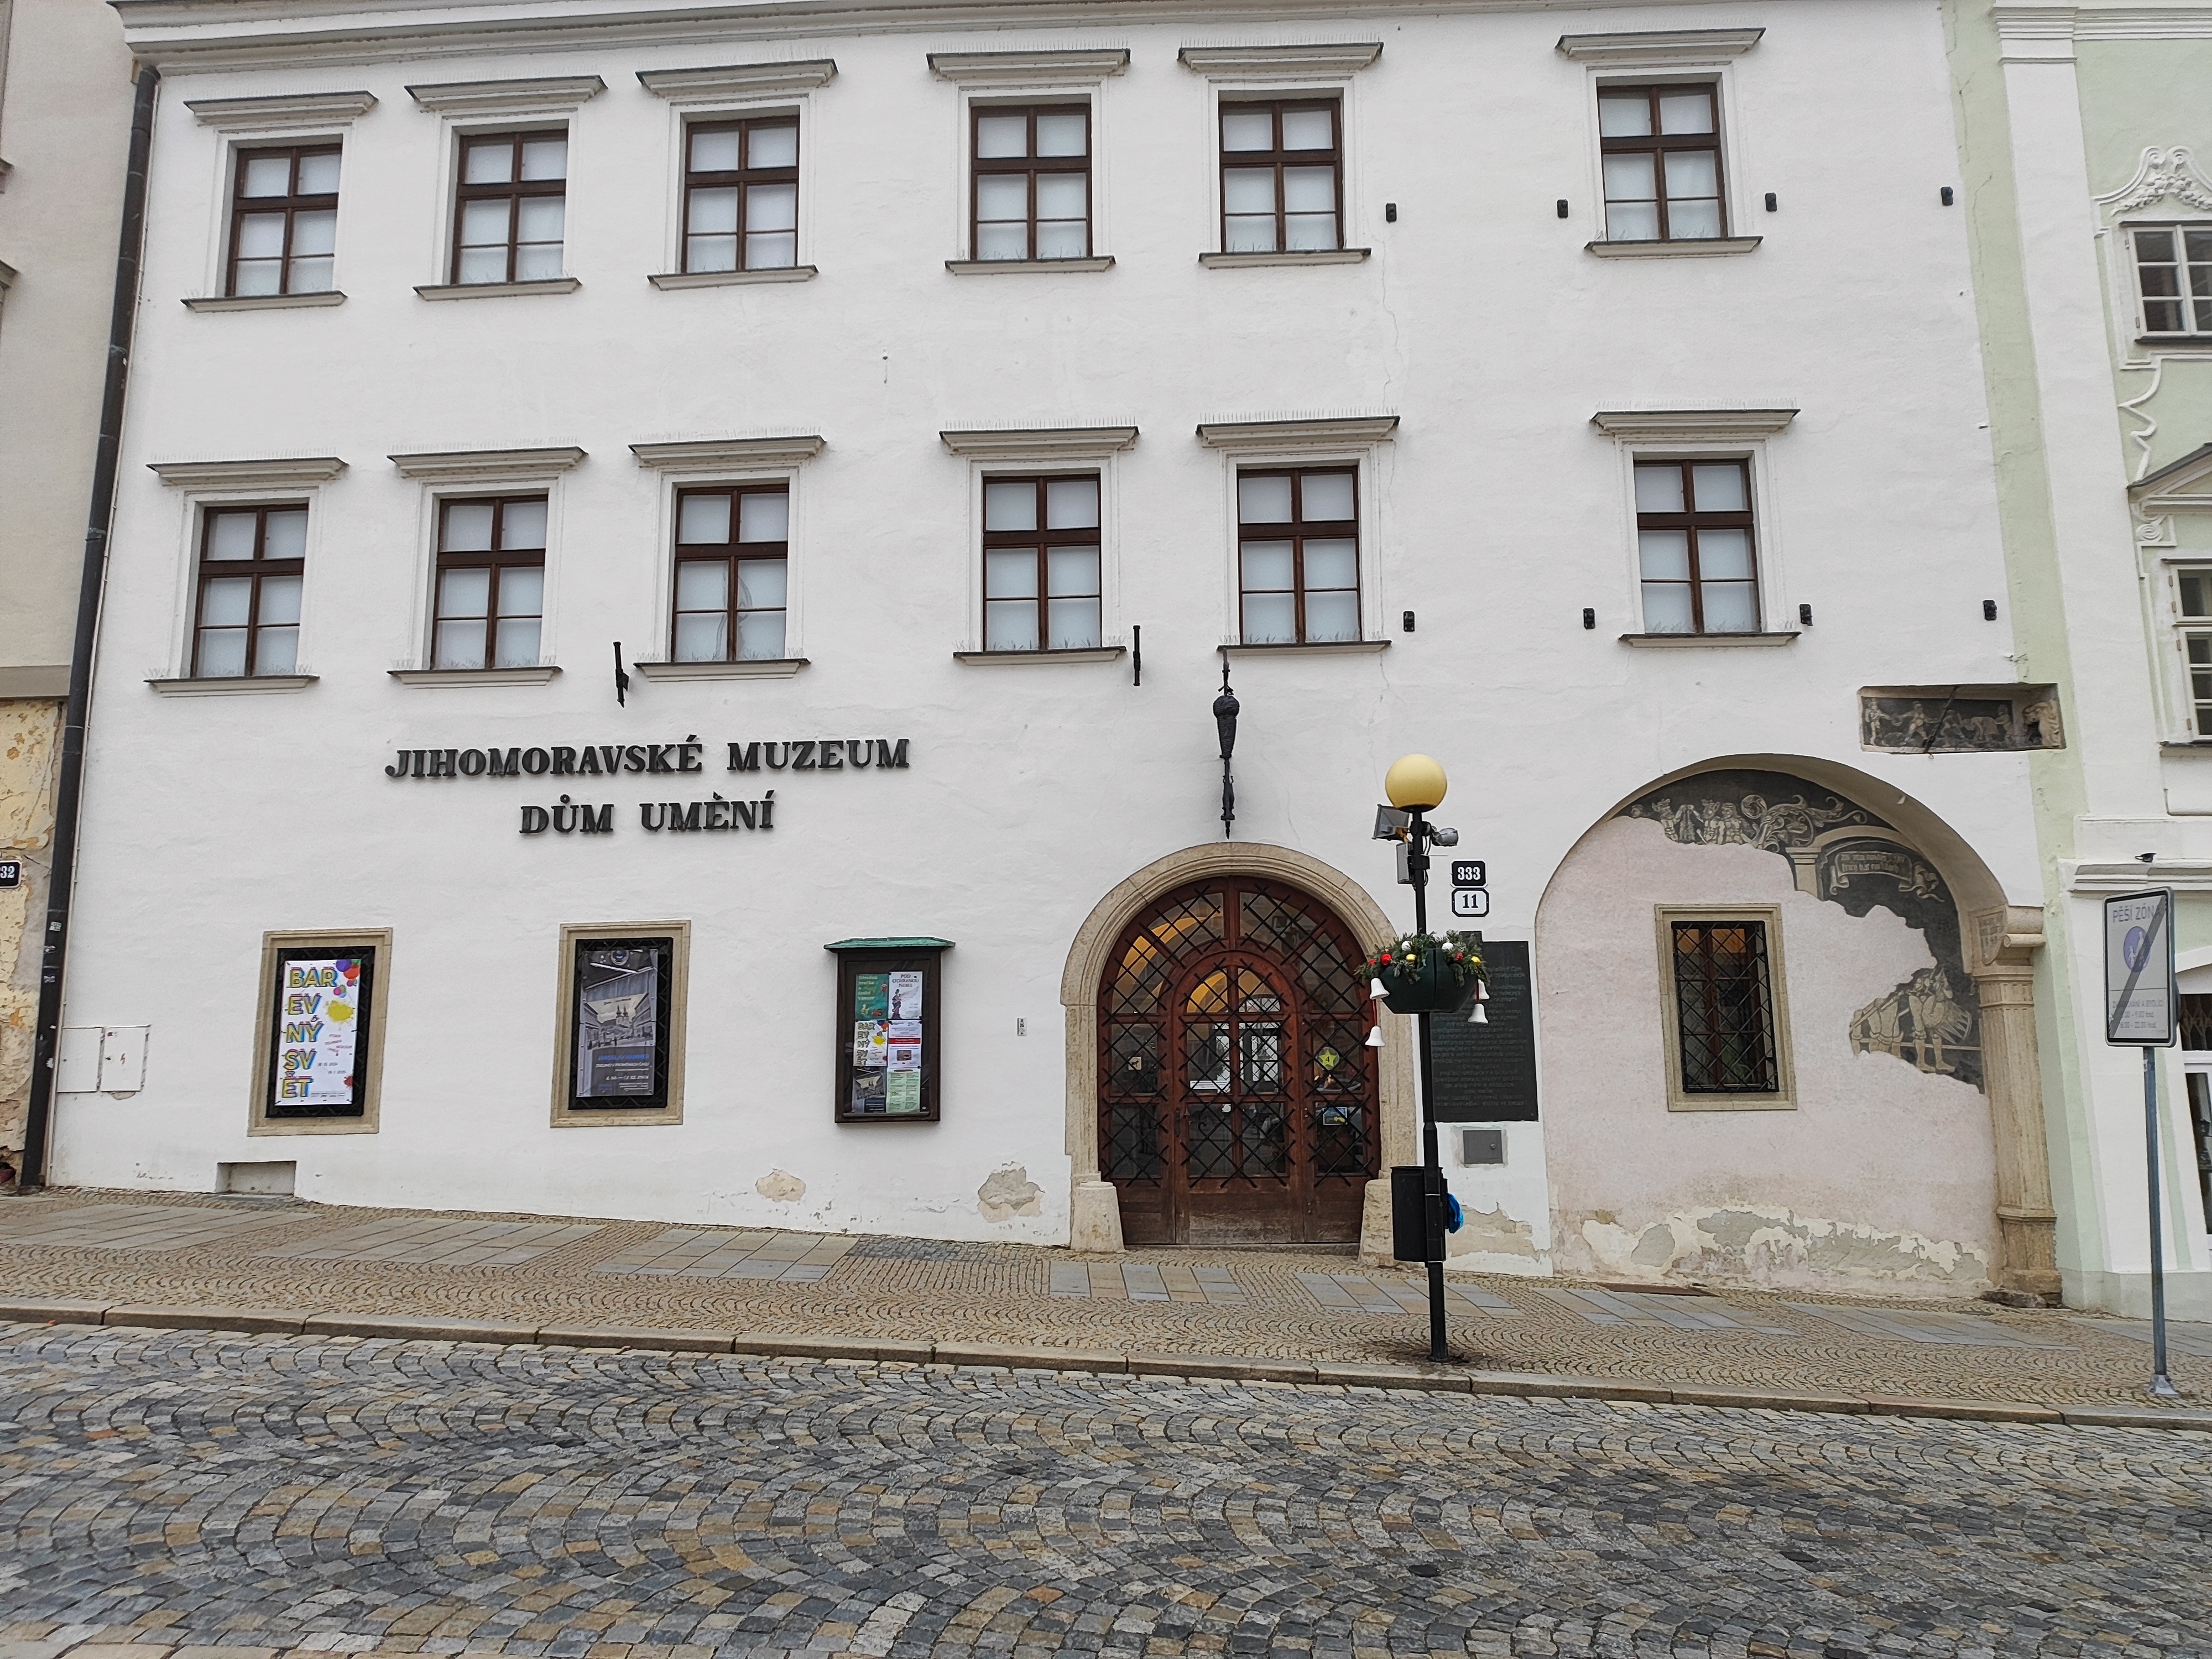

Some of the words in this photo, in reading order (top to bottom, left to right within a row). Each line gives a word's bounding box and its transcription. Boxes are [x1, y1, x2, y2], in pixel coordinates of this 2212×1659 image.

[384, 734, 703, 778] JIHOMORAVSKÉ
[727, 738, 910, 771] MUZEUM
[519, 794, 614, 834] DŮM
[1457, 867, 1481, 880] 333
[1462, 893, 1479, 909] 11
[2112, 904, 2133, 923] PĚŠÍ
[289, 967, 338, 988] BAR
[288, 993, 321, 1015] EV
[286, 1015, 324, 1043] NÝ
[283, 1048, 317, 1070] SV
[281, 1071, 314, 1098] ĚT
